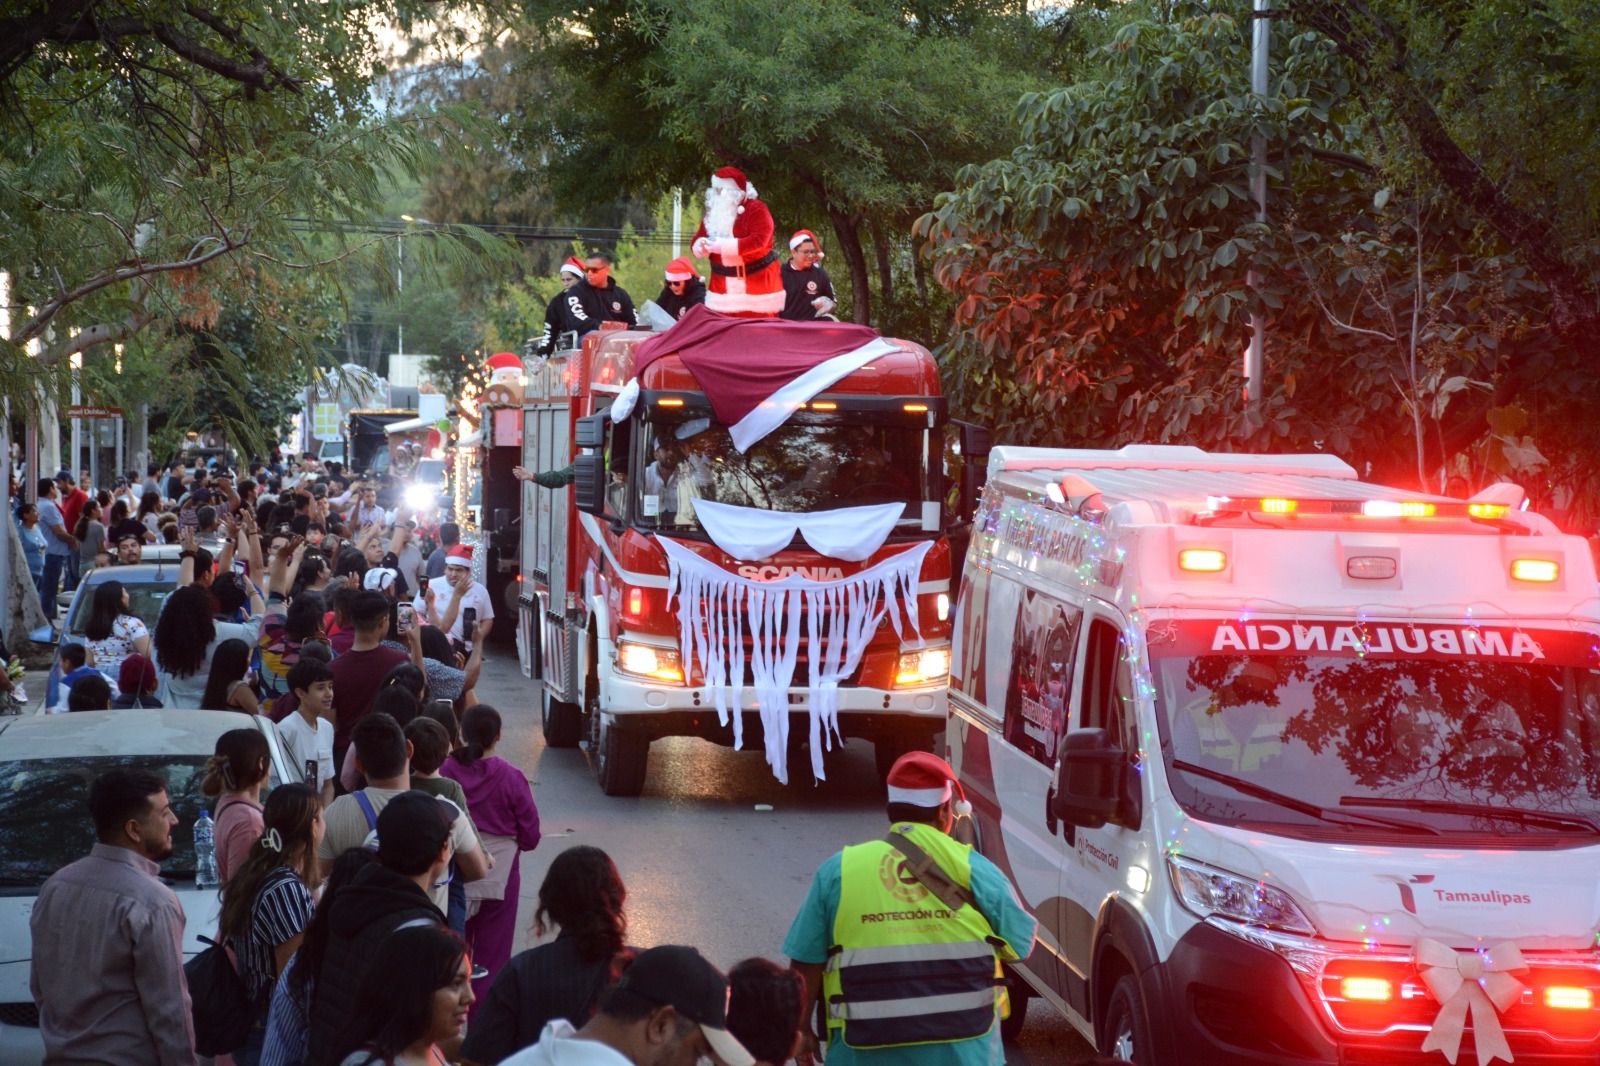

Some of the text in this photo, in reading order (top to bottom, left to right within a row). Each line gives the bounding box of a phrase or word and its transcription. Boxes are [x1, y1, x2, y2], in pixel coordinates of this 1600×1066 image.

[738, 565, 845, 582] SCANIA
[1433, 889, 1533, 906] Tamaulipas
[861, 908, 933, 924] PROTECCIÓN
